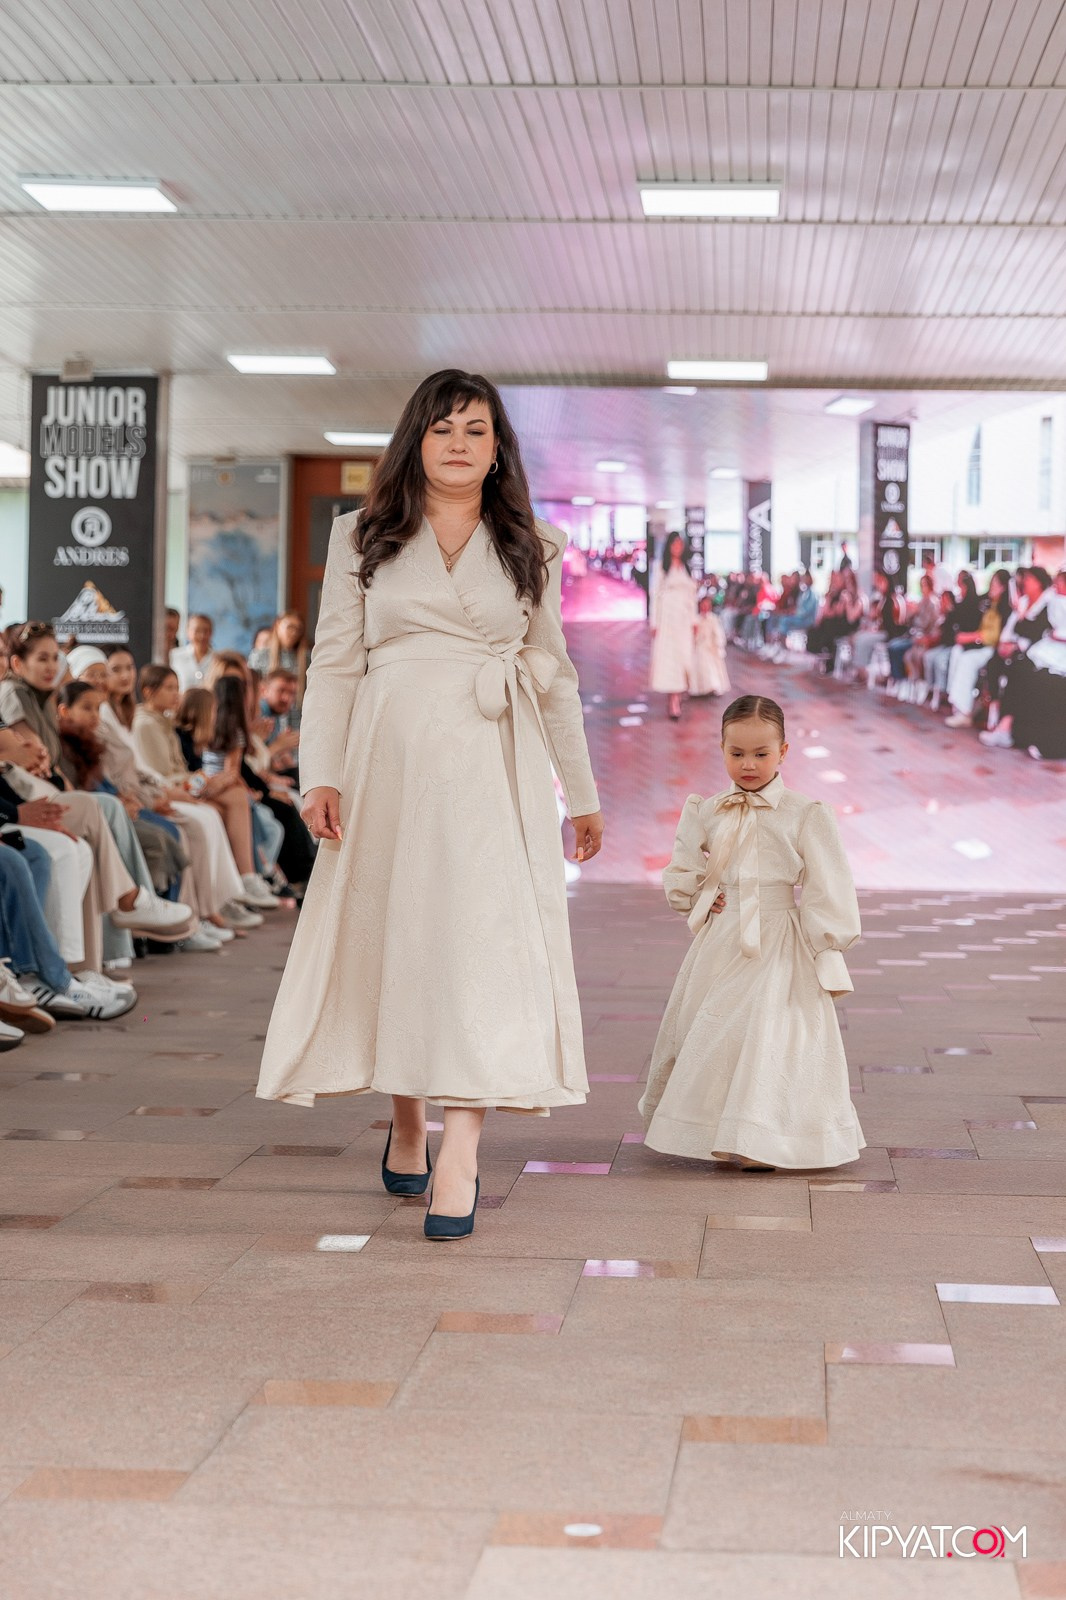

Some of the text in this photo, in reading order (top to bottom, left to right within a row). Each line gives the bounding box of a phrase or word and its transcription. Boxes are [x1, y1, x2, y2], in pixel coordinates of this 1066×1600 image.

[41, 386, 147, 427] JUNIOR
[40, 424, 147, 459] MODELS
[44, 456, 141, 499] SHOW
[53, 546, 129, 566] ANDRES
